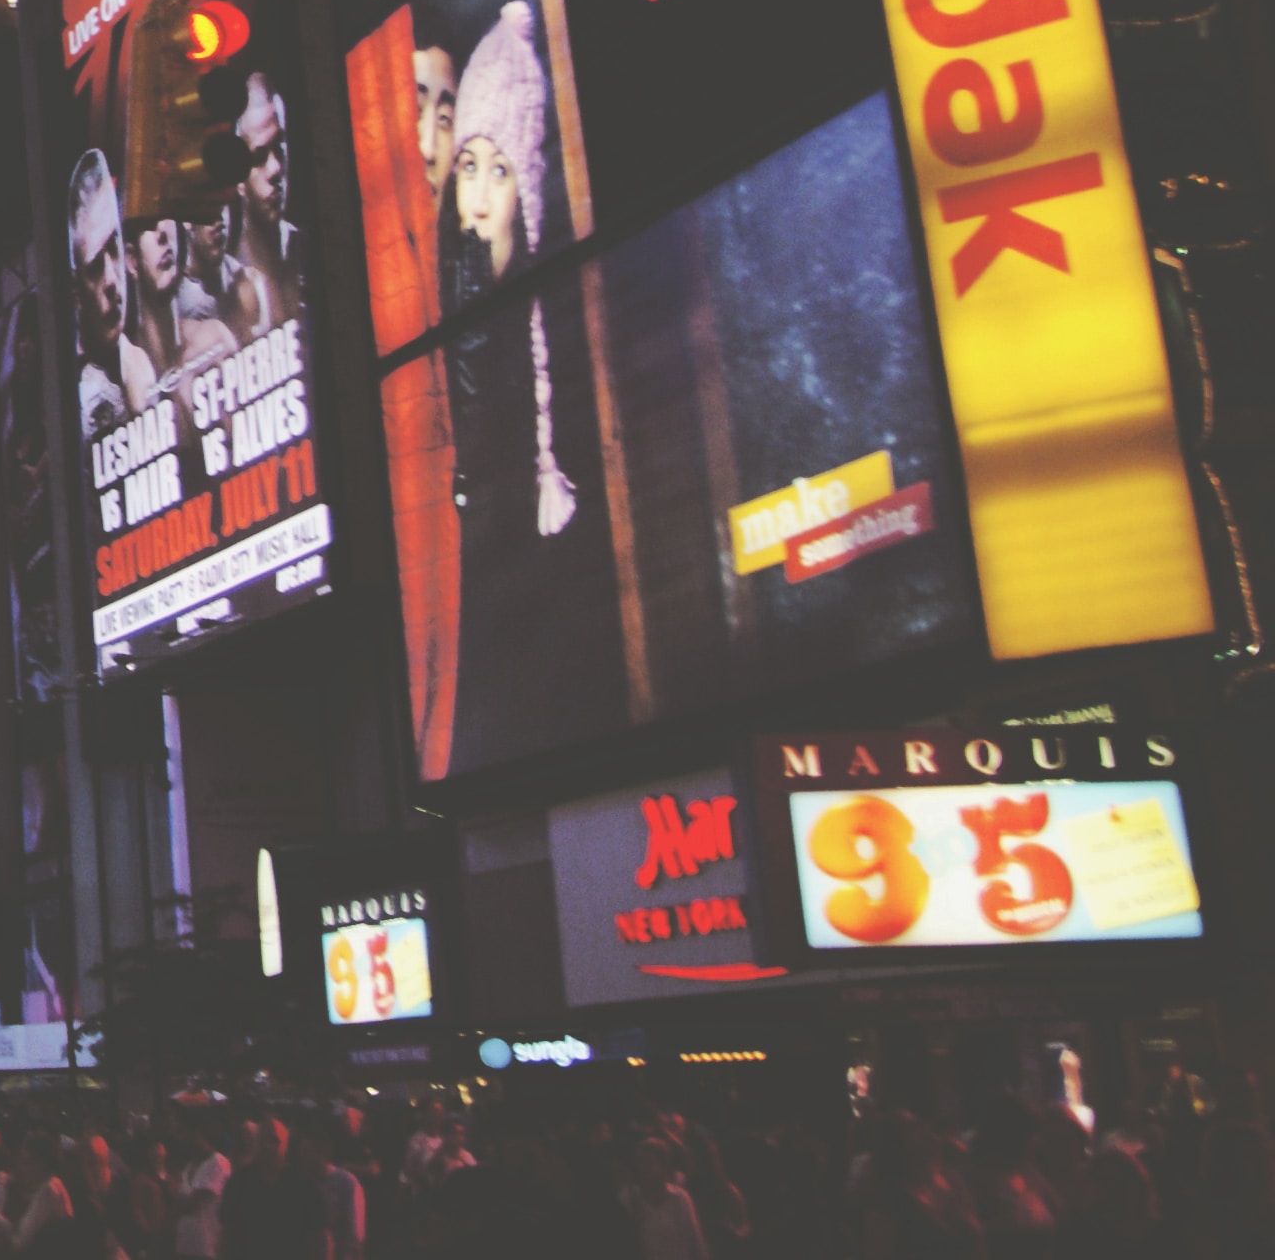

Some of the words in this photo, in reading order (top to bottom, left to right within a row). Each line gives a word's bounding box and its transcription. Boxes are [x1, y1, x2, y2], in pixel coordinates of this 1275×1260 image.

[68, 7, 100, 55] LIVE
[192, 318, 304, 430] ST-PIERRE
[92, 399, 178, 490] LESNAR
[231, 379, 310, 467] ALVES
[124, 453, 182, 525] MIR
[220, 455, 280, 537] JULY
[280, 438, 317, 503] 11
[737, 476, 851, 555] make
[100, 611, 118, 636] LIVE
[120, 596, 156, 628] VIEWING
[157, 583, 185, 615] PARTY
[198, 565, 227, 592] RADIO
[230, 551, 251, 579] CITY
[254, 531, 288, 566] MUSIC
[291, 516, 321, 550] HALL
[798, 504, 919, 568] something
[780, 734, 1177, 779] MARQUIS
[321, 891, 426, 926] MARQUIS
[808, 794, 931, 945] 9
[957, 792, 1075, 937] 5
[614, 907, 670, 944] NEW
[676, 896, 747, 936] YORK
[327, 933, 358, 1021] 9
[367, 929, 397, 1017] 5
